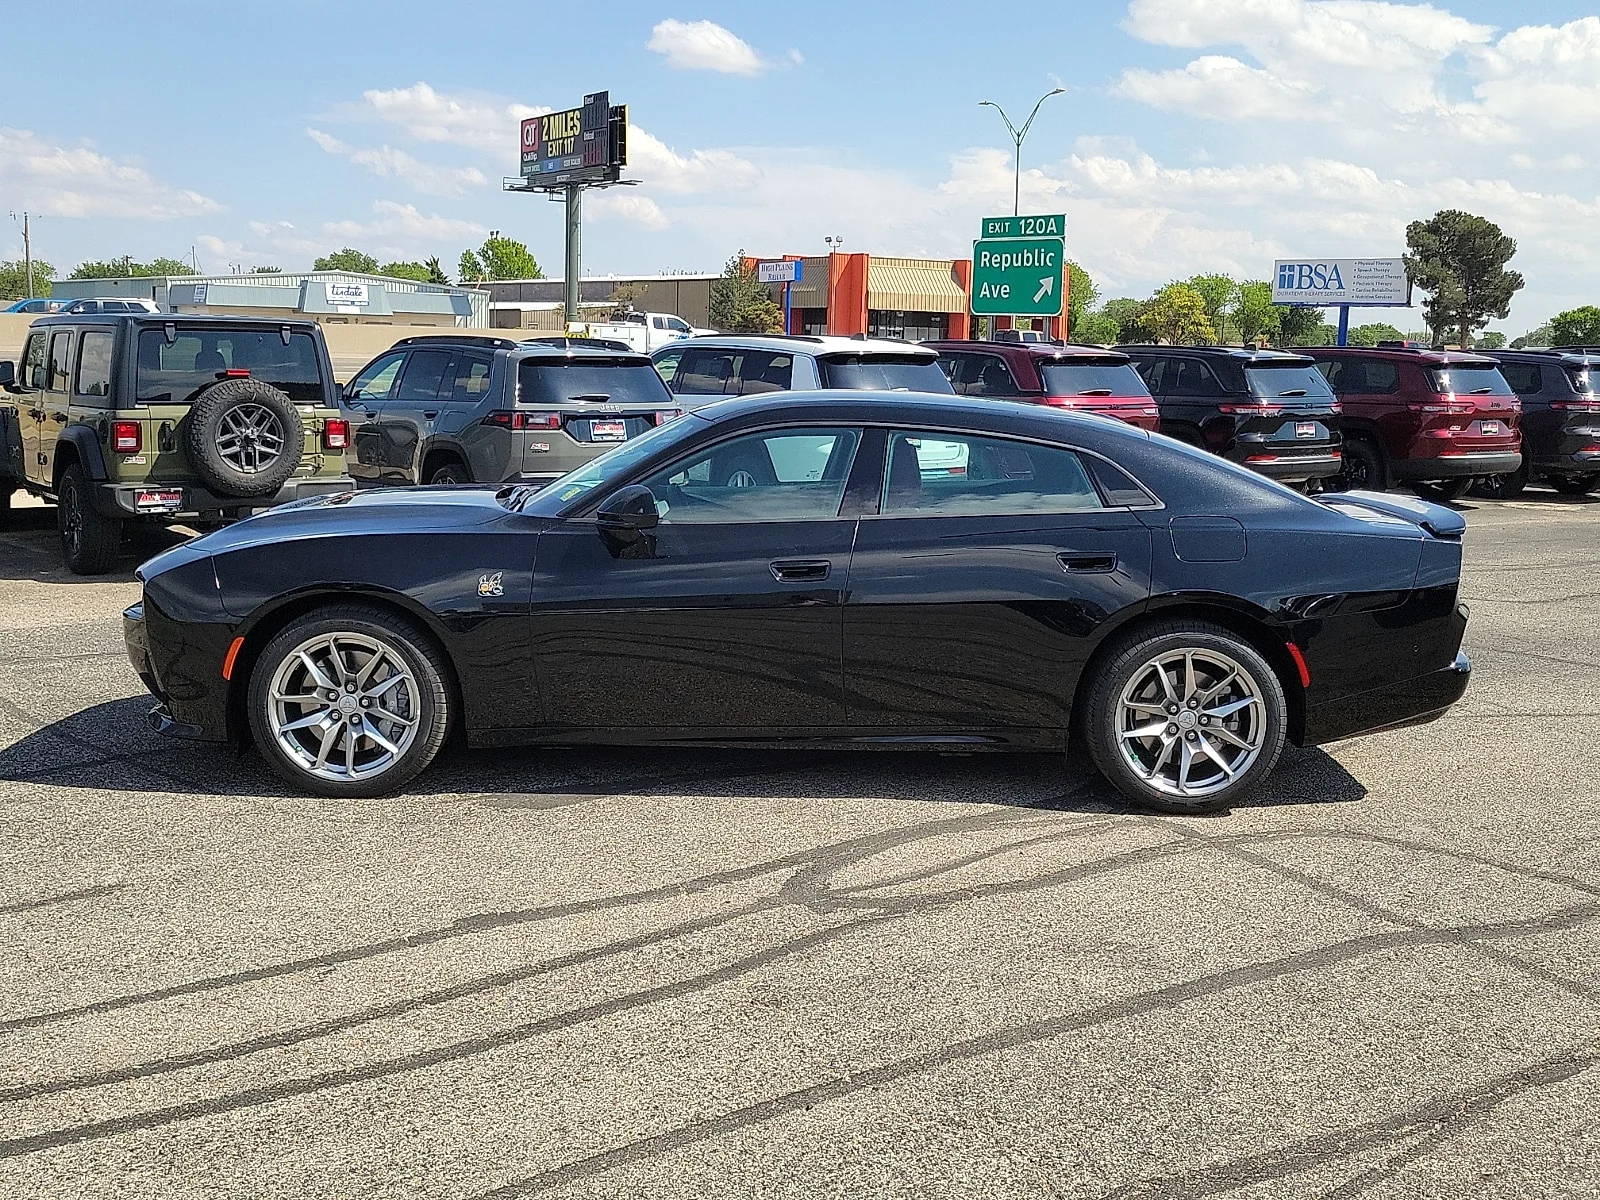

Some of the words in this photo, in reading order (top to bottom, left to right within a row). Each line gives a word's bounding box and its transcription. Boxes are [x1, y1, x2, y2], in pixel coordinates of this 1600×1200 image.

[523, 123, 536, 146] QT
[542, 117, 549, 142] 2
[550, 110, 581, 141] MILES
[547, 139, 563, 158] EXIT
[564, 137, 575, 155] 117
[988, 222, 1011, 234] EXIT
[1019, 218, 1057, 235] 120A
[980, 248, 1055, 272] Republic
[1295, 263, 1346, 290] BSA
[979, 282, 1010, 299] Ave
[600, 403, 621, 412] Jeep
